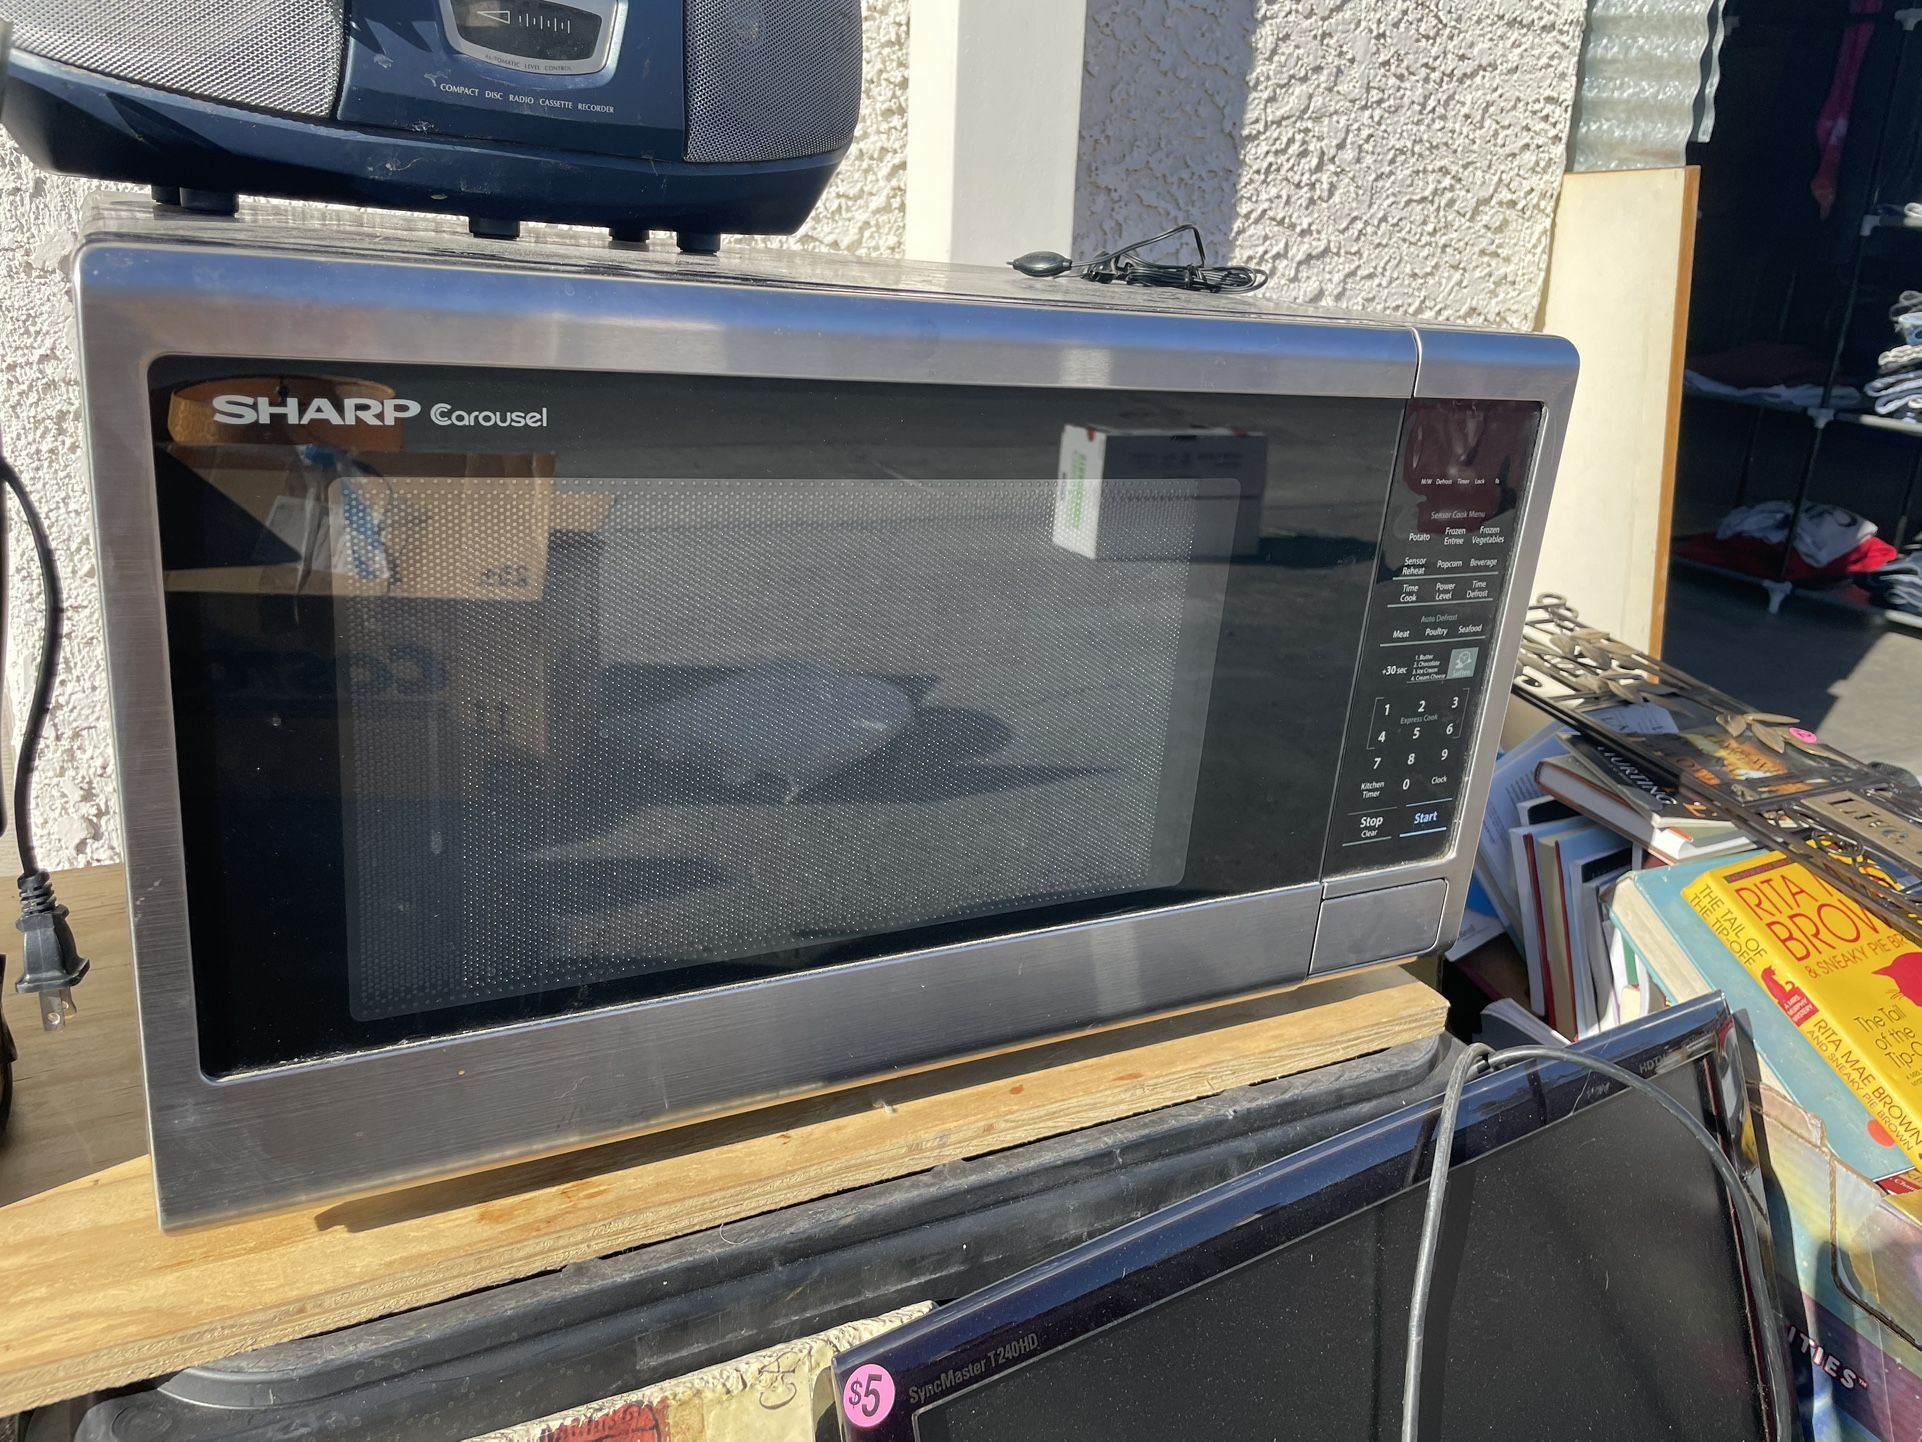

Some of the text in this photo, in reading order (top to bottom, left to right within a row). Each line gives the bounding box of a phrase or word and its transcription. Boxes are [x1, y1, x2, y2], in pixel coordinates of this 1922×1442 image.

[524, 63, 540, 71] LEVEL
[440, 83, 614, 113] COMPACT DISC RADIO CASSETTE RECORDER
[212, 394, 547, 427] SHARP Carousel
[1431, 510, 1486, 520] Sensor Cook Menu
[1445, 527, 1466, 536] Frozen
[1480, 526, 1500, 534] Frozen
[1409, 532, 1430, 541] Potato
[1444, 537, 1464, 546] Entree
[1472, 535, 1504, 546] Vegetables
[1404, 556, 1426, 566] Sensor
[1437, 559, 1462, 569] Popcorn
[1470, 558, 1498, 568] Beverage
[1402, 566, 1425, 576] Reheat
[1403, 584, 1418, 593] Time
[1436, 582, 1456, 591] Power
[1472, 580, 1486, 588] Time
[1400, 594, 1417, 602] Cook
[1436, 592, 1452, 600] Level
[1466, 589, 1488, 598] Defrost
[1421, 614, 1458, 623] Auto Defrost
[1392, 630, 1410, 638] Meat
[1425, 628, 1448, 637] Poultry
[1458, 624, 1482, 634] Seafood
[1382, 666, 1408, 676] +30 sec
[1418, 700, 1426, 712] 2
[1451, 697, 1458, 708] 3
[1384, 704, 1390, 716] 1
[1400, 713, 1438, 726] Express Cook
[1412, 727, 1420, 739] 5
[1446, 723, 1454, 734] 6
[1378, 731, 1386, 742] 4
[1407, 753, 1415, 765] 8
[1440, 749, 1448, 760] 9
[1373, 758, 1381, 769] 7
[1360, 780, 1384, 790] Kitchen
[1402, 778, 1410, 790] 0
[1431, 776, 1448, 785] Clock
[1362, 790, 1380, 799] Timer
[1360, 816, 1384, 829] Stop
[1414, 811, 1438, 824] Start
[1361, 829, 1378, 838] Clear
[1735, 874, 1818, 921] RITA
[1699, 884, 1768, 959] THE TAIL OF
[1688, 894, 1756, 967] THE TIP-OFF
[1806, 966, 1818, 979] &
[1817, 949, 1868, 974] SNEAKY
[1868, 940, 1890, 958] PIE
[1854, 1004, 1907, 1033] The Tail
[1875, 1026, 1916, 1050] of the
[1814, 1018, 1842, 1051] RITA
[1841, 1050, 1876, 1086] MAE
[1872, 1086, 1922, 1146] BROWN
[1806, 1030, 1828, 1052] AND
[1828, 1053, 1864, 1091] SNEAKY
[1862, 1092, 1878, 1108] PIE
[1877, 1110, 1914, 1151] BROWN
[909, 1333, 1039, 1404] SyncMaster T240HD
[849, 1373, 882, 1417] $5
